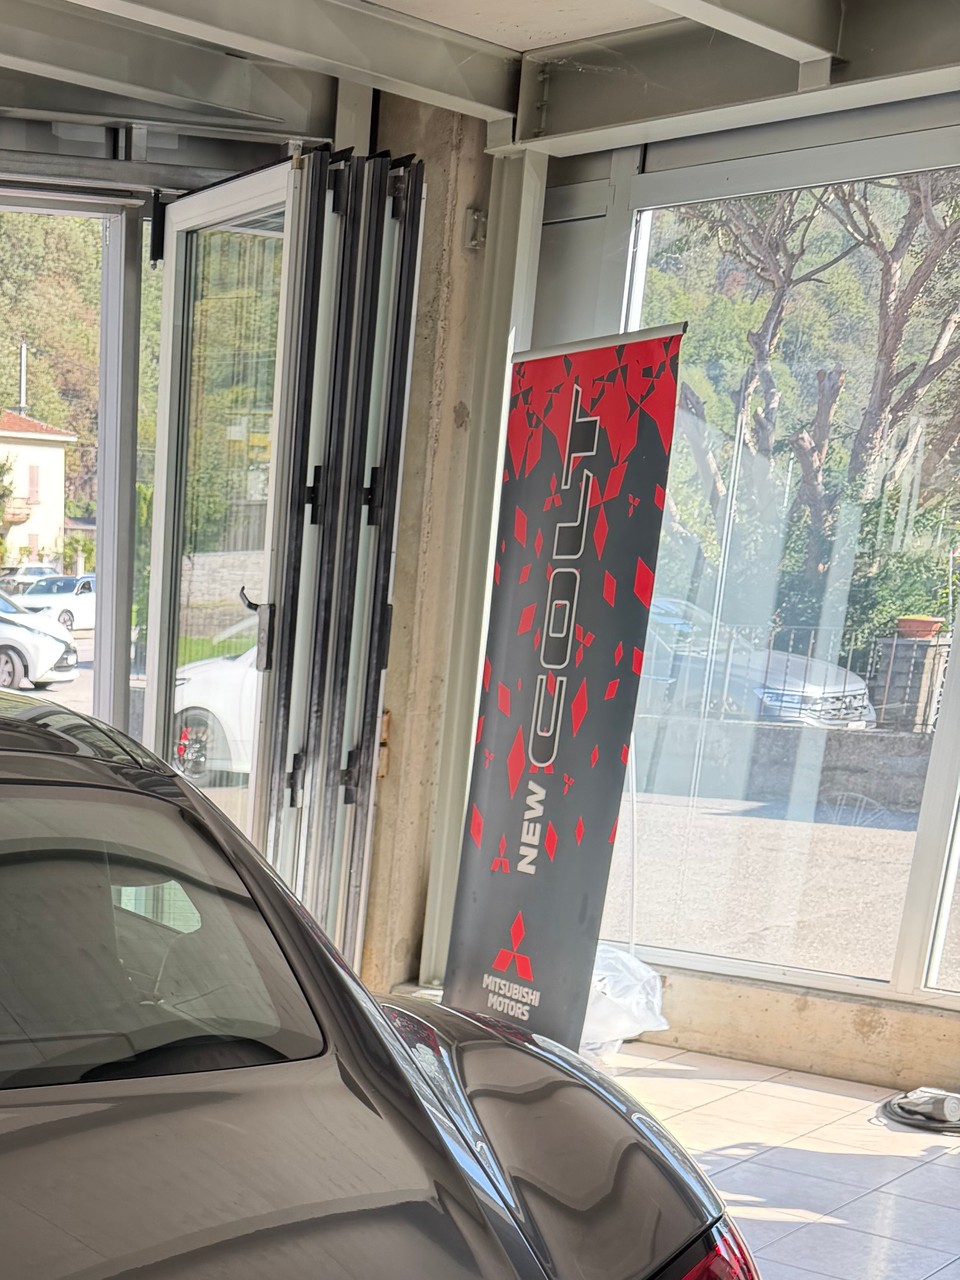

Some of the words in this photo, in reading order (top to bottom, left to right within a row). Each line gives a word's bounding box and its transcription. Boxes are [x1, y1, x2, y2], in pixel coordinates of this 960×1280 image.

[528, 383, 601, 768] COLT
[516, 780, 548, 875] NEW
[482, 973, 541, 1007] MITSUBISHI
[487, 993, 531, 1021] MOTORS
